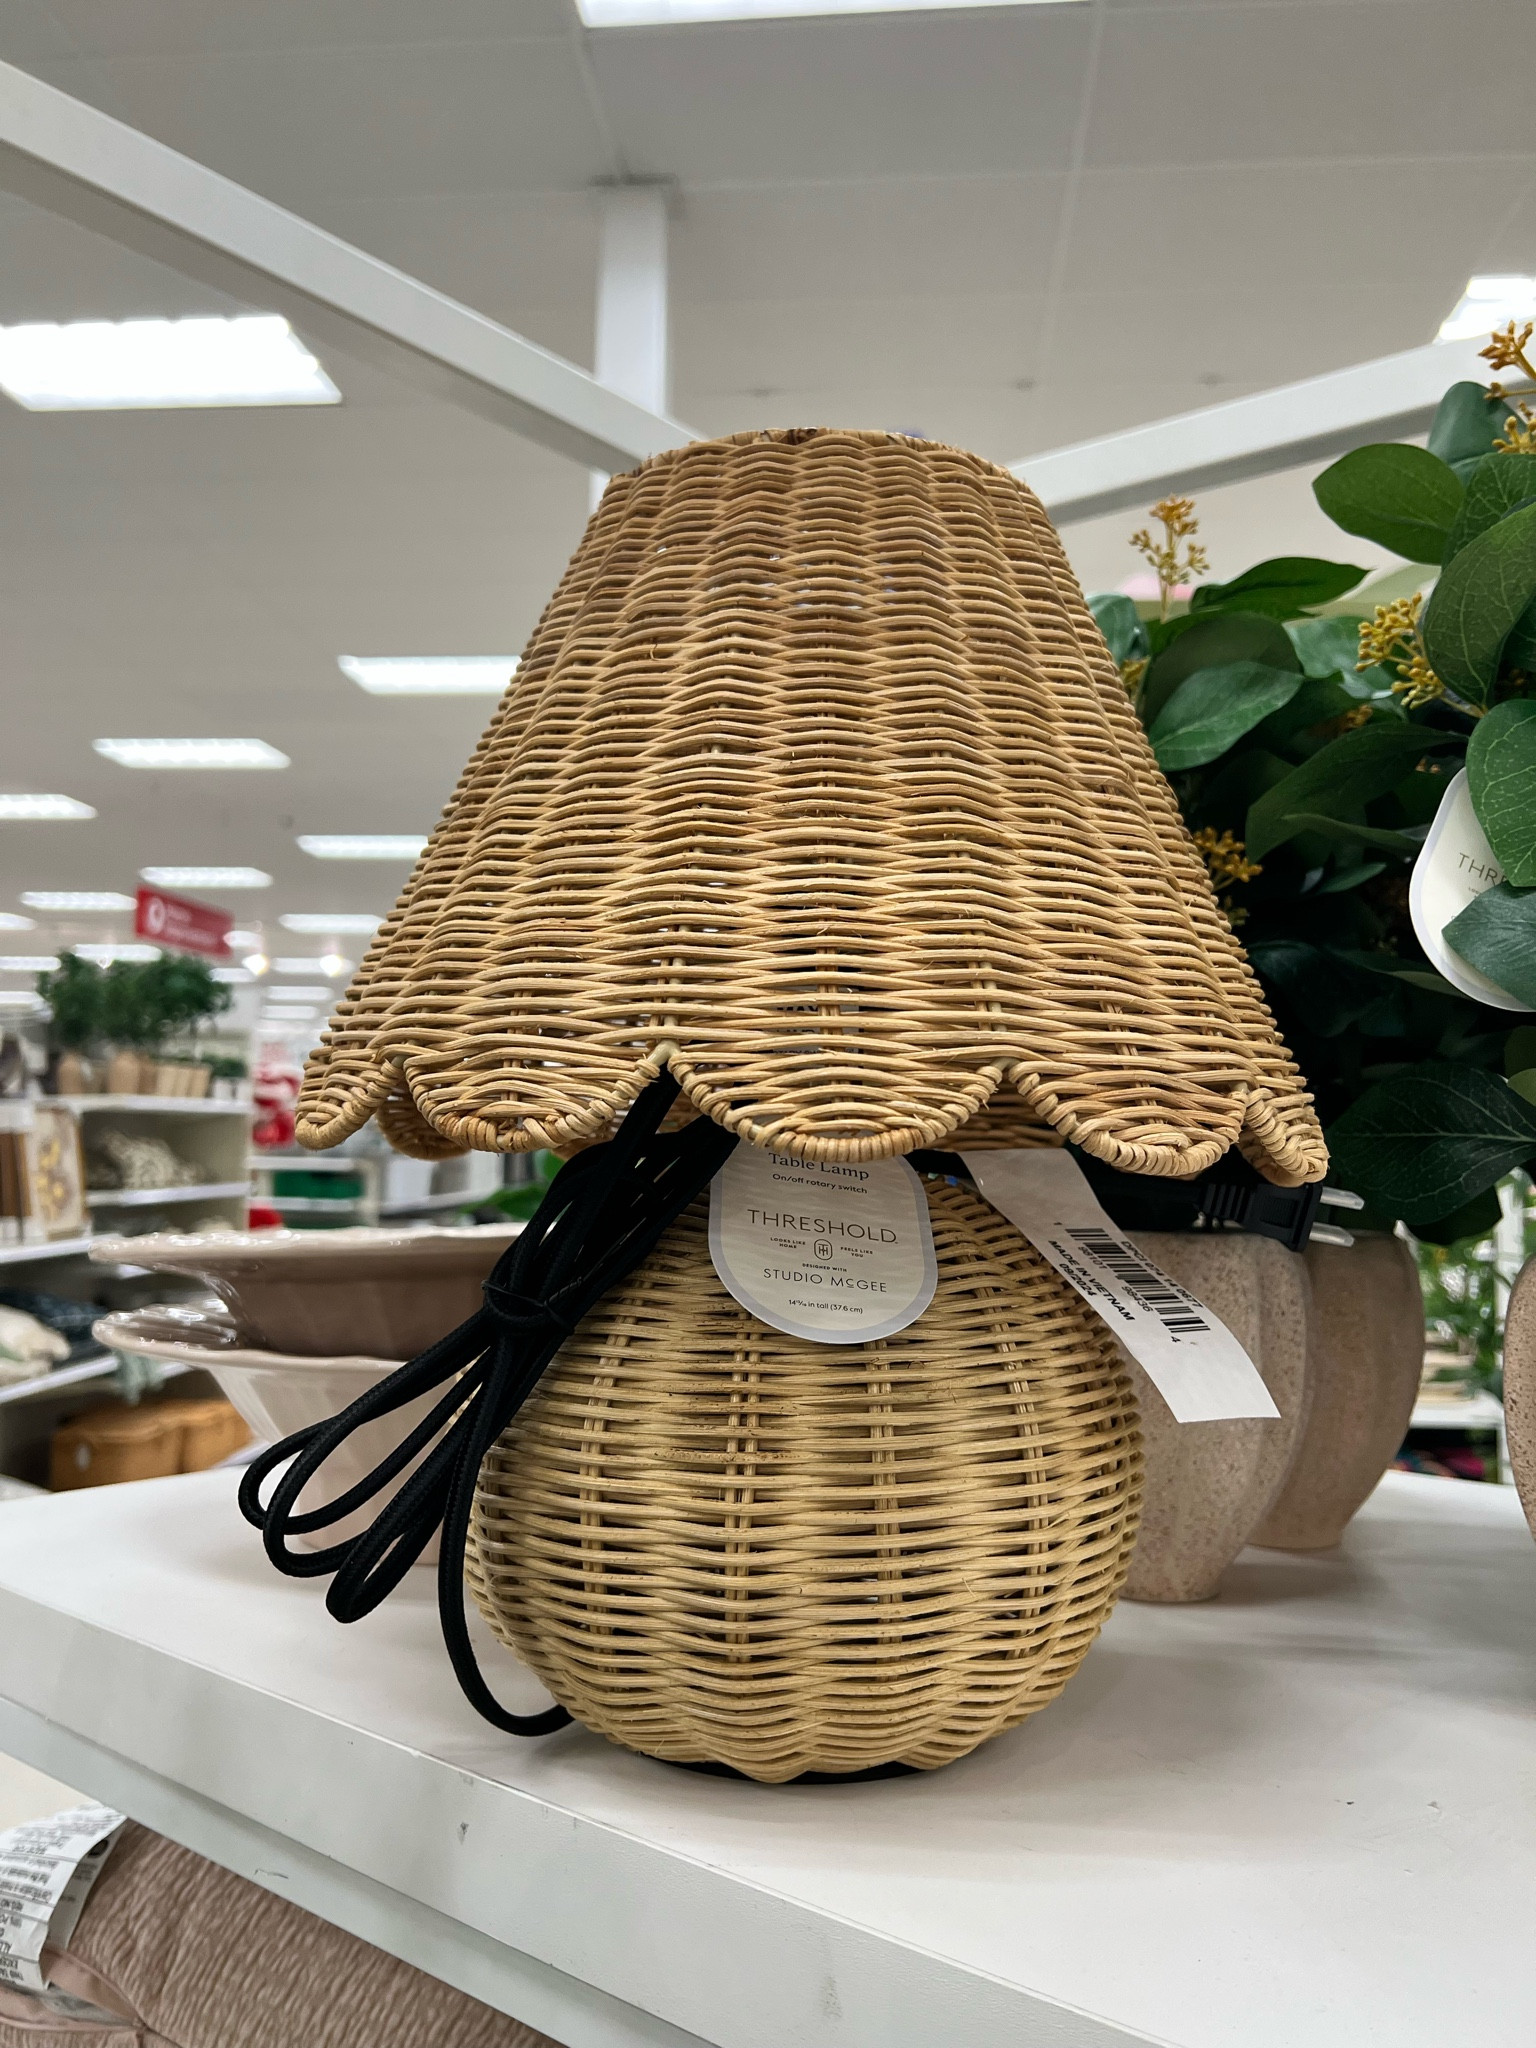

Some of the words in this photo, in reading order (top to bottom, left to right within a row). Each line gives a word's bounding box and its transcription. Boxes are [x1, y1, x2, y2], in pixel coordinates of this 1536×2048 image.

[768, 1152, 815, 1170] Table
[820, 1161, 869, 1181] Lamp
[772, 1173, 804, 1184] On/off
[806, 1179, 836, 1190] rotary
[838, 1184, 868, 1194] switch
[747, 1209, 898, 1243] THRESHOLD
[1121, 1241, 1147, 1261] DPCI
[763, 1268, 823, 1284] STUDIO
[802, 1263, 831, 1271] DESIGNED
[1048, 1240, 1080, 1266] MADE
[1076, 1268, 1091, 1276] IN
[1089, 1278, 1135, 1321] VIETNAM
[1059, 1263, 1097, 1296] 09/2024
[816, 1302, 829, 1310] tall
[830, 1303, 848, 1312] (37.6
